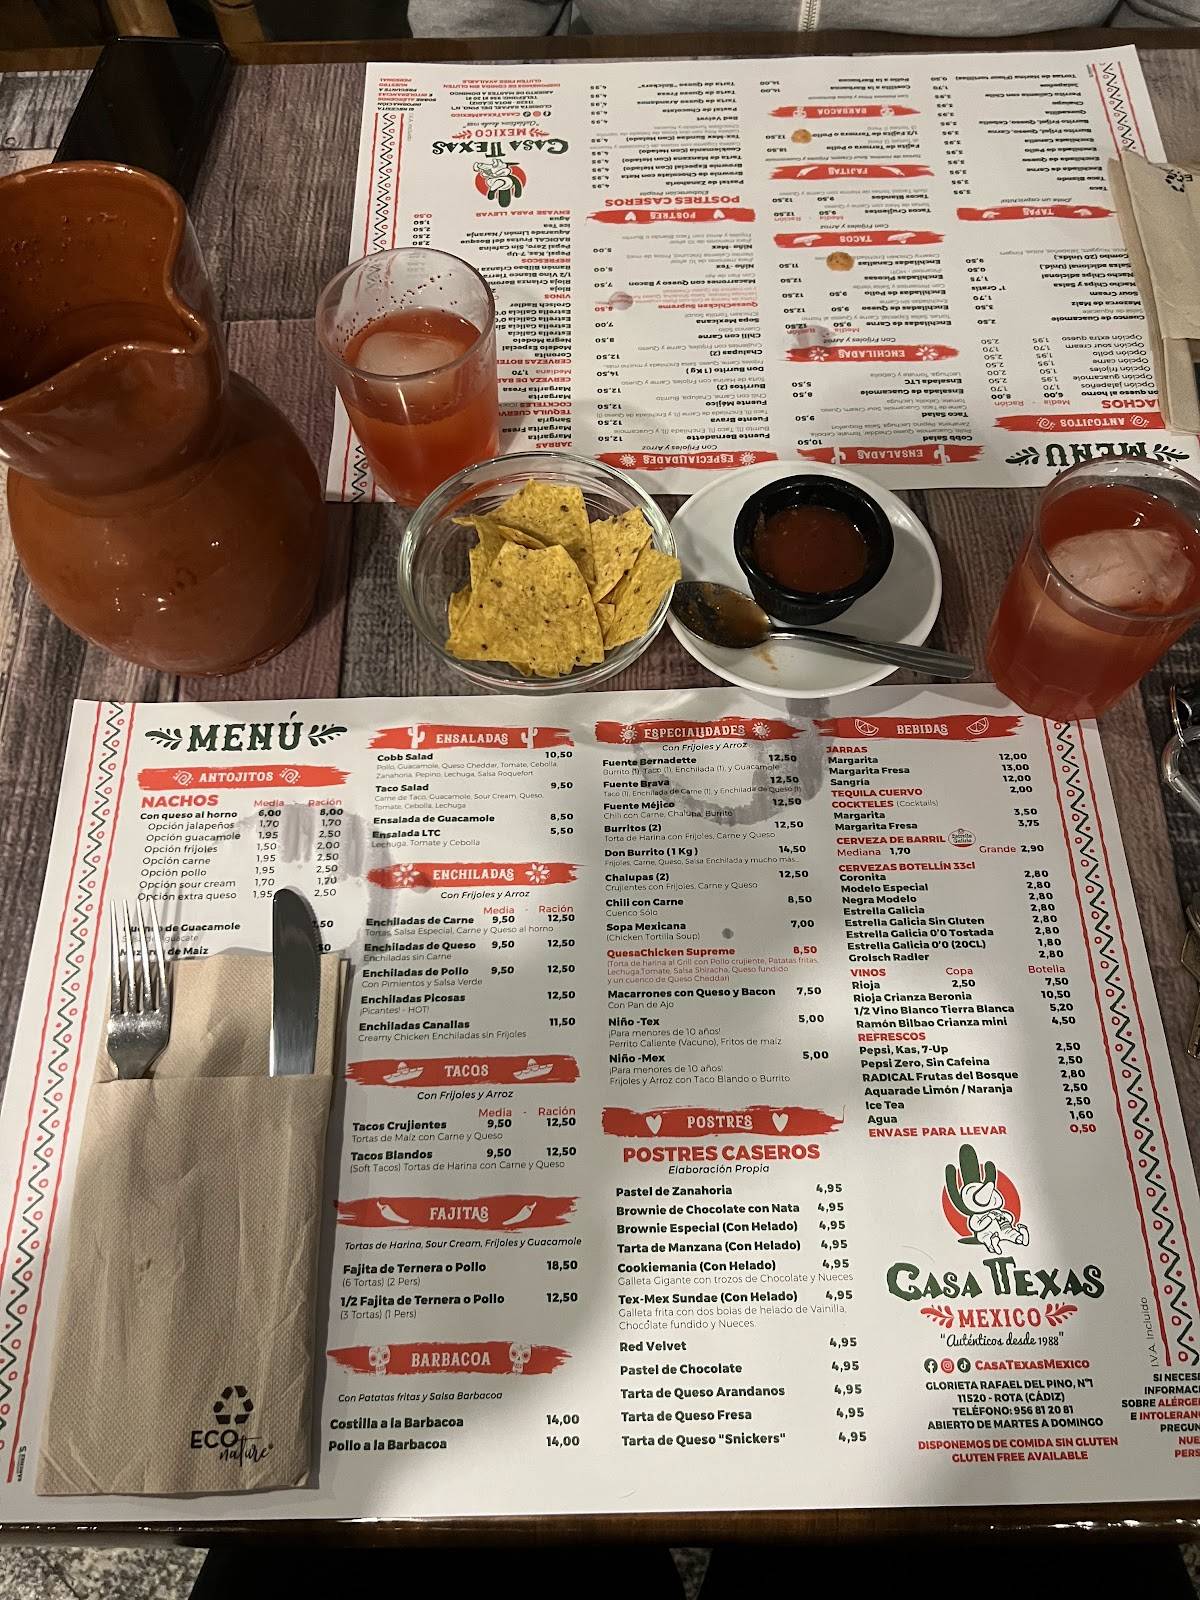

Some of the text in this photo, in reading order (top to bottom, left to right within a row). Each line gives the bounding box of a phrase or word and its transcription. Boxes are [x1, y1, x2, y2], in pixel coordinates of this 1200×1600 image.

[475, 128, 526, 137] MEXICO
[828, 167, 868, 175] FAJITAS
[605, 196, 740, 206] POSTRES CASEROS
[839, 235, 872, 243] TACOS
[838, 349, 905, 357] ENCHILADAS
[1073, 374, 1120, 382] guacamole
[1123, 373, 1152, 381] Opción
[1060, 418, 1125, 427] ANTOJITOS
[856, 449, 923, 459] ENSALADAS
[188, 711, 304, 751] MENÚ
[897, 724, 948, 736] BEBIDAS
[436, 734, 509, 745] ENSALADAS
[545, 751, 573, 759] 10,50
[829, 767, 879, 775] Margarita
[1002, 764, 1029, 772] 13,00
[199, 772, 274, 782] ANTOJITOS
[142, 795, 342, 808] NACHOS Media Ración
[148, 819, 342, 831] Opción jalapeños 1,70 1,70
[838, 861, 975, 872] CERVEZAS BOTELLÍN 33cl
[433, 869, 514, 881] ENCHILADAS
[606, 899, 629, 907] Chili
[366, 918, 425, 926] Enchiladas
[492, 916, 515, 924] 9,50
[548, 914, 575, 922] 12,50
[607, 949, 684, 958] QuesaChicken
[793, 946, 817, 954] 8,50
[851, 965, 1065, 977] VINOS Copa Botella
[852, 978, 1068, 990] Rioja 2,50 7,50
[660, 1001, 674, 1009] Ajo
[858, 1032, 926, 1042] REFRESCOS
[444, 1065, 489, 1077] TACOS
[353, 1118, 576, 1131] Tacos Crujientes 9,50 12,50
[688, 1116, 753, 1129] POSTRES
[869, 1124, 1096, 1137] ENVASE PARA LLEVAR 0,50
[623, 1144, 820, 1162] POSTRES CASEROS
[669, 1164, 769, 1174] Elaboración Propia
[616, 1184, 843, 1196] Pastel de Zanahoria 4,95
[430, 1207, 489, 1222] FAJITAS
[343, 1261, 578, 1275] Fajita de Ternera o Pollo 18,50
[618, 1273, 853, 1285] Galleta Gigante con trozos de Chocolate y Nueces
[958, 1308, 1041, 1328] MEXICO
[1005, 1333, 1036, 1346] desde
[411, 1352, 491, 1367] BARBACOA
[1122, 1396, 1200, 1407] SOBRE ALÉRGE
[952, 1405, 1074, 1416] TELÉFONO: 956 81 20 81
[330, 1415, 580, 1429] Costilla a la Barbacoa 14,00
[191, 1429, 238, 1449] ECO
[622, 1432, 867, 1447] Tarta de Queso "Snickers" 4,95
[952, 1451, 1088, 1463] GLUTEN FREE AVAILABLE
